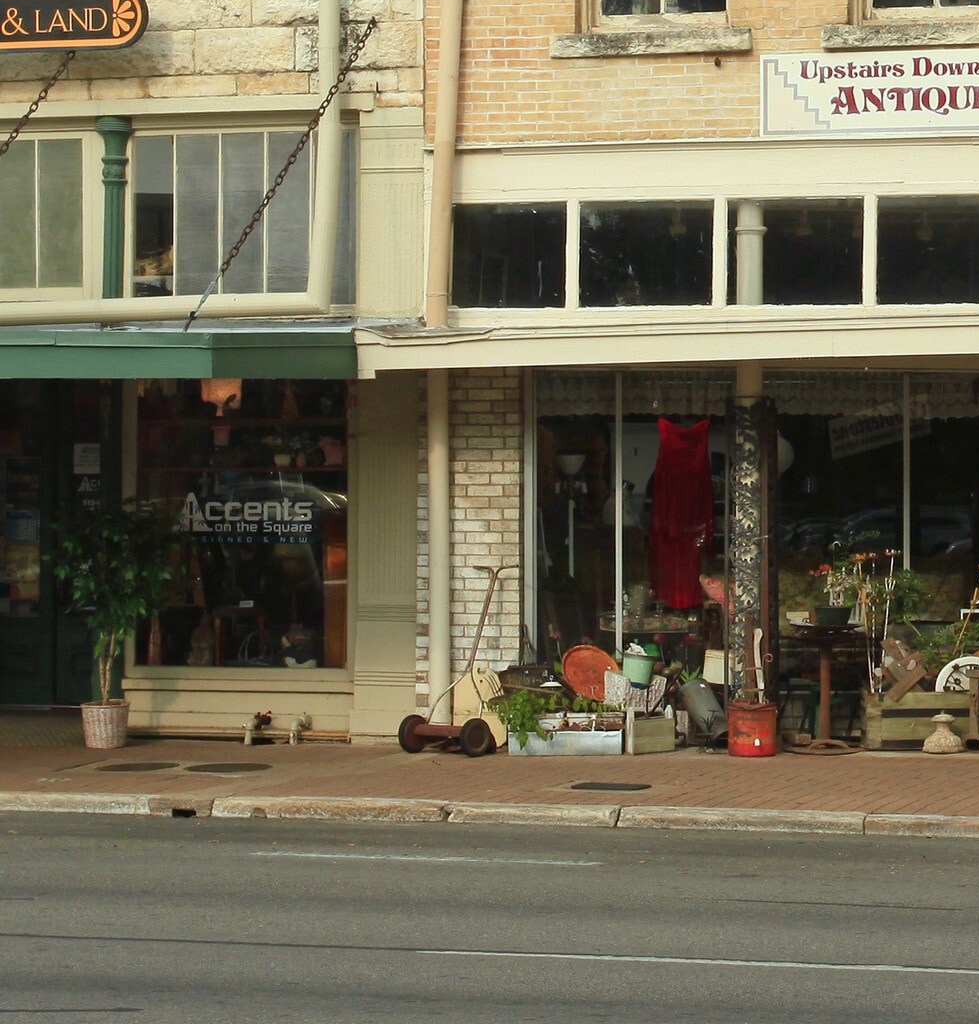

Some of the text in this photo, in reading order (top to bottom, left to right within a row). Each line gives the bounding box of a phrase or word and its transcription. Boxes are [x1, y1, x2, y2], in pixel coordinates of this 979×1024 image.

[1, 7, 108, 36] & LAND
[799, 59, 905, 83] Upstairs
[172, 492, 314, 532] Accents
[214, 521, 312, 535] on the Square
